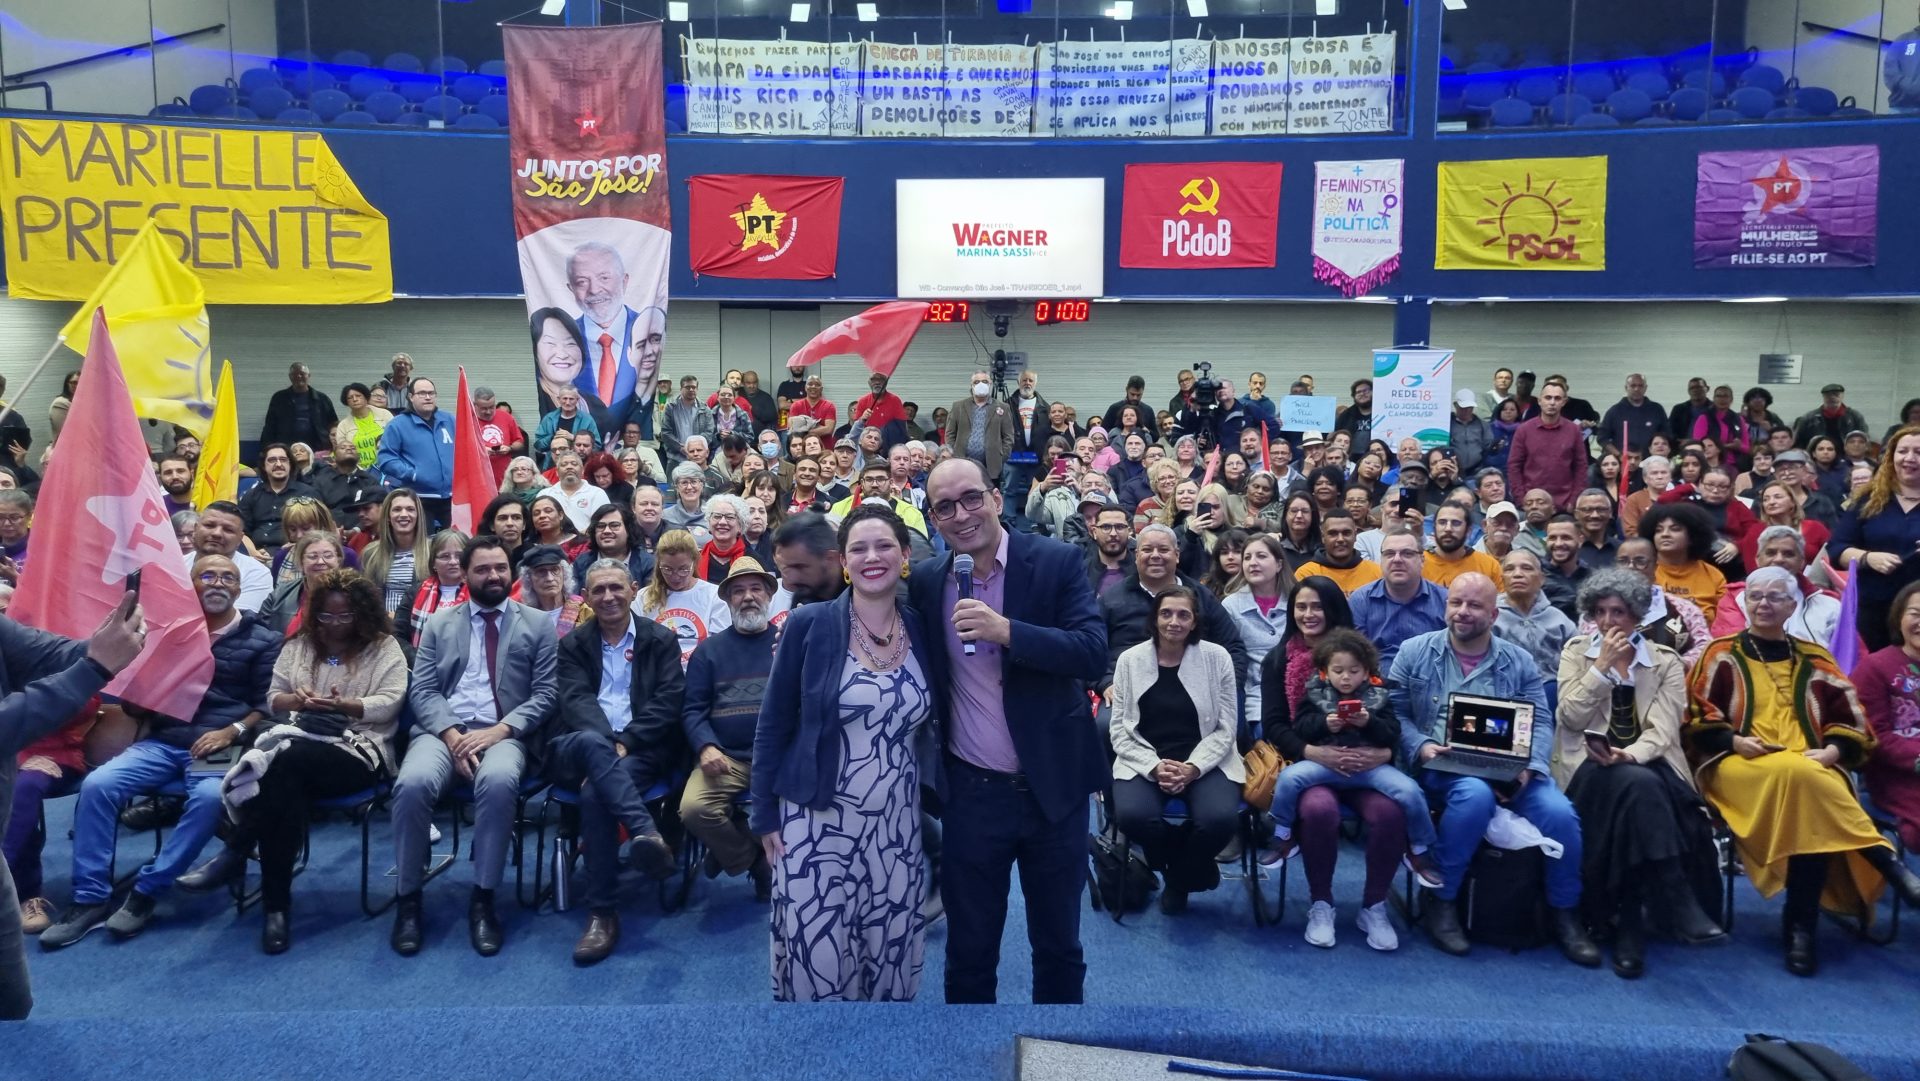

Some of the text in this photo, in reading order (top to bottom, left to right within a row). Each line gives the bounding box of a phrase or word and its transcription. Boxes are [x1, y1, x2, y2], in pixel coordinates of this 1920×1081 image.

[695, 42, 756, 57] QUEREMOS
[765, 46, 799, 56] FAZER
[807, 46, 841, 56] PARTE
[869, 45, 918, 61] CHEGA
[926, 48, 943, 61] DE
[948, 45, 1012, 62] TIRANIA
[1132, 49, 1171, 59] CAMPOS
[1235, 41, 1292, 57] NOSSA
[697, 60, 841, 80] MAPA DA CIDADE
[956, 67, 964, 82] E
[968, 66, 1034, 82] QUEREMOS
[1220, 60, 1279, 76] NOSSA
[1348, 55, 1383, 75] NÃO
[698, 83, 836, 104] MAIS RICA DO
[872, 86, 894, 101] UM
[961, 87, 981, 103] AS
[1220, 81, 1304, 99] ROUBAMOS
[1313, 80, 1332, 94] OU
[1118, 93, 1166, 106] RIQUEZA
[994, 110, 1015, 124] DE
[1221, 105, 1237, 114] DE
[583, 120, 596, 129] PT
[734, 109, 810, 130] BRASIL
[1049, 116, 1064, 129] SE
[1073, 112, 1117, 129] APLICA
[1129, 115, 1158, 127] NOS
[11, 120, 320, 192] MARIELLE
[517, 153, 662, 180] JUNTOS POR
[525, 169, 586, 199] São
[1320, 178, 1397, 194] FEMINISTAS
[1773, 182, 1793, 195] PT
[1347, 197, 1364, 213] NA
[747, 215, 776, 235] PT
[1324, 213, 1389, 231] POLÍTICA
[16, 195, 373, 271] PRESENTE
[952, 222, 1049, 246] WAGNER
[1162, 218, 1232, 257] PCdoB
[1741, 230, 1819, 242] MULHERES
[956, 248, 1000, 257] MARINA
[1002, 247, 1032, 257] SASSI
[1507, 233, 1581, 262] PSOL
[1730, 252, 1828, 265] FILIE-SE AO PT
[1391, 389, 1432, 401] REDE 18
[1384, 401, 1438, 410] SÃO JOSÉ DOS
[441, 427, 453, 444] A
[127, 498, 169, 553] PT
